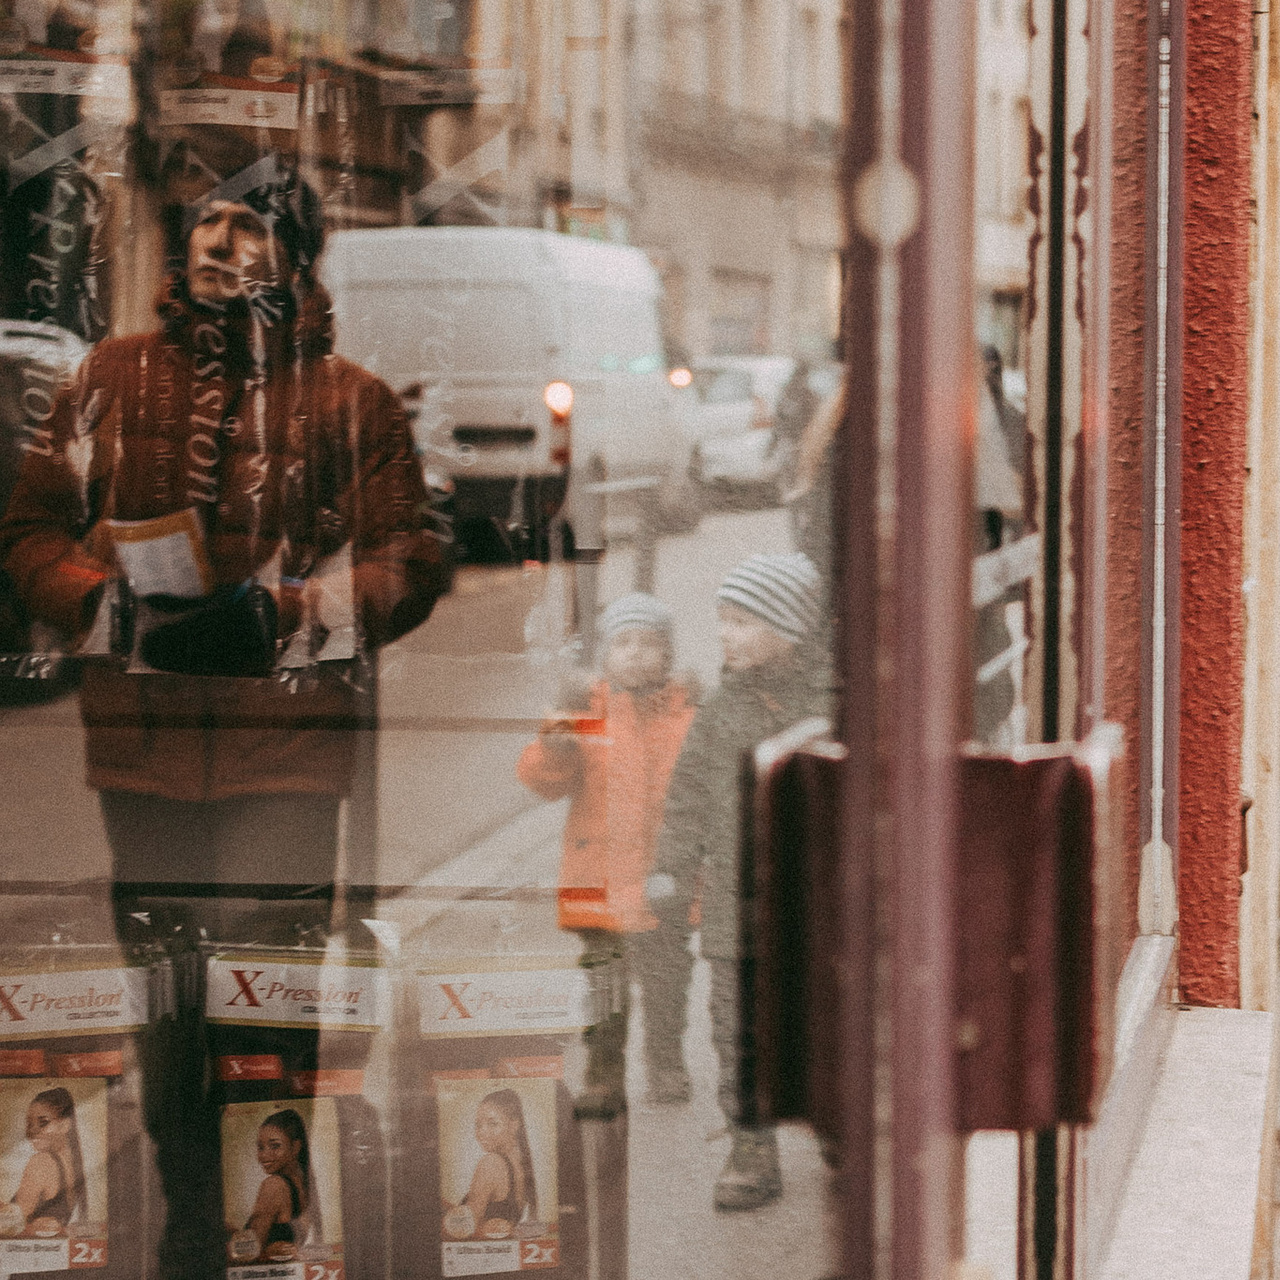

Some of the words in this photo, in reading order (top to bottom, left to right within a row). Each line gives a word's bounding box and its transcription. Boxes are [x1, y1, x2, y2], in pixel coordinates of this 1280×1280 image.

[225, 969, 364, 1008] X-Pression
[71, 1242, 104, 1263] 2x
[523, 1243, 556, 1264] 2x
